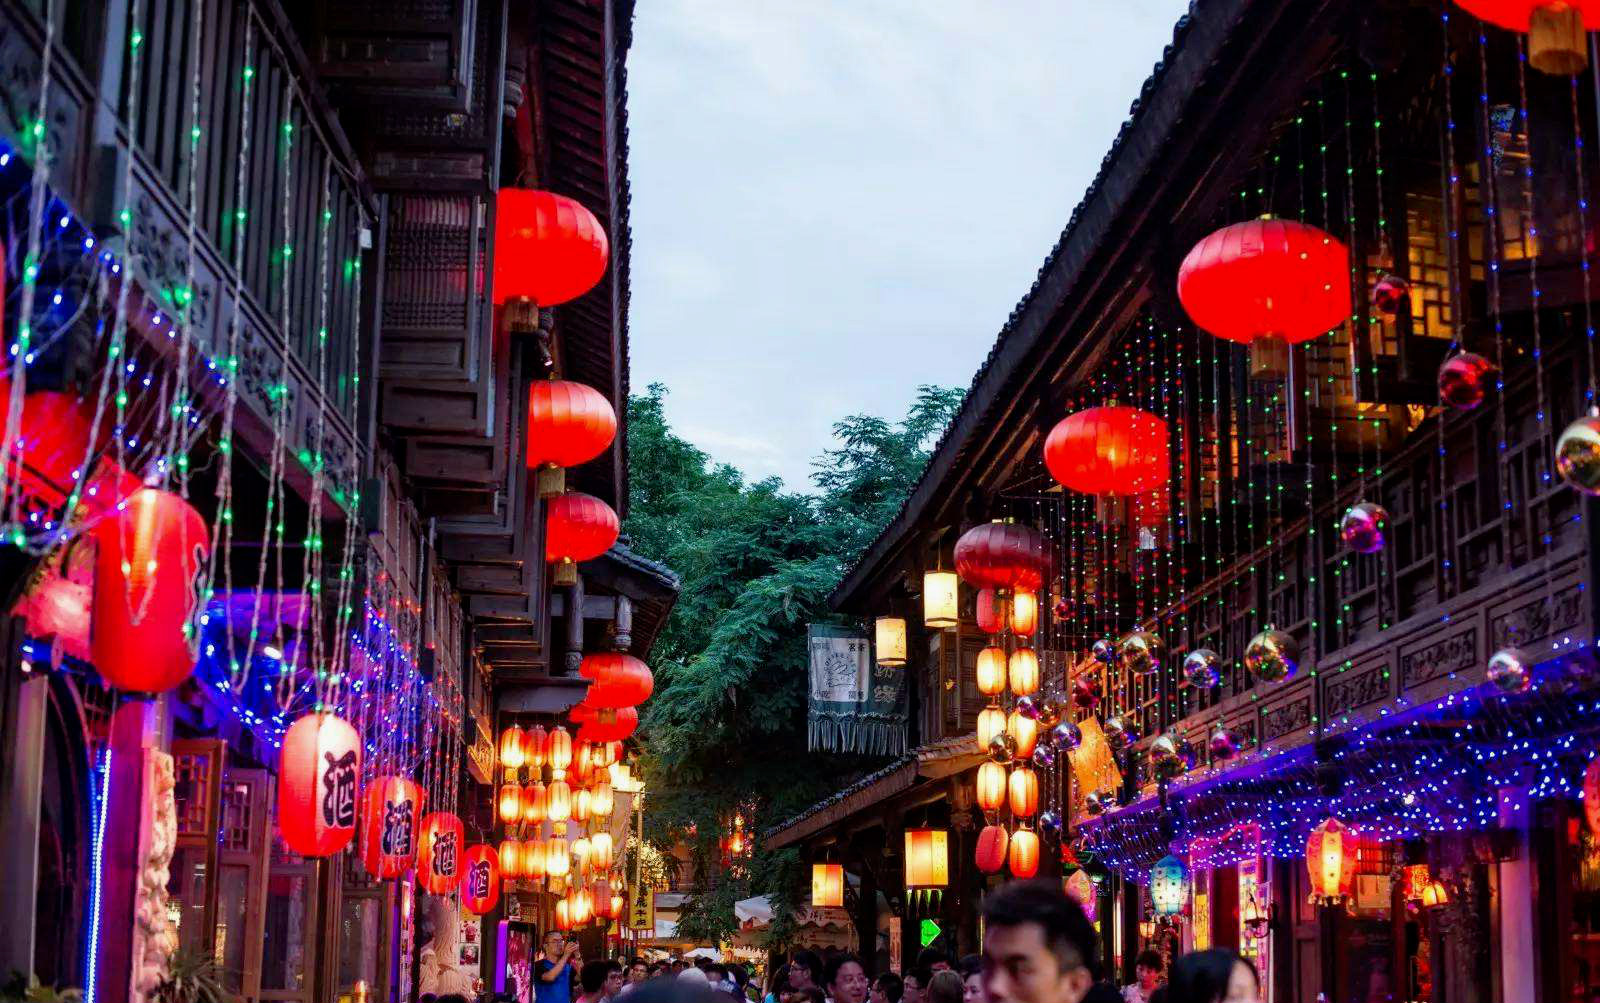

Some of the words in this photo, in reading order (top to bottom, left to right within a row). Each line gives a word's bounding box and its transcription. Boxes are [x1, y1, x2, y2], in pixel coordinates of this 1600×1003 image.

[322, 749, 357, 828] 酒
[382, 799, 413, 856] 酒
[433, 830, 456, 876] 酒
[469, 860, 490, 899] 酒
